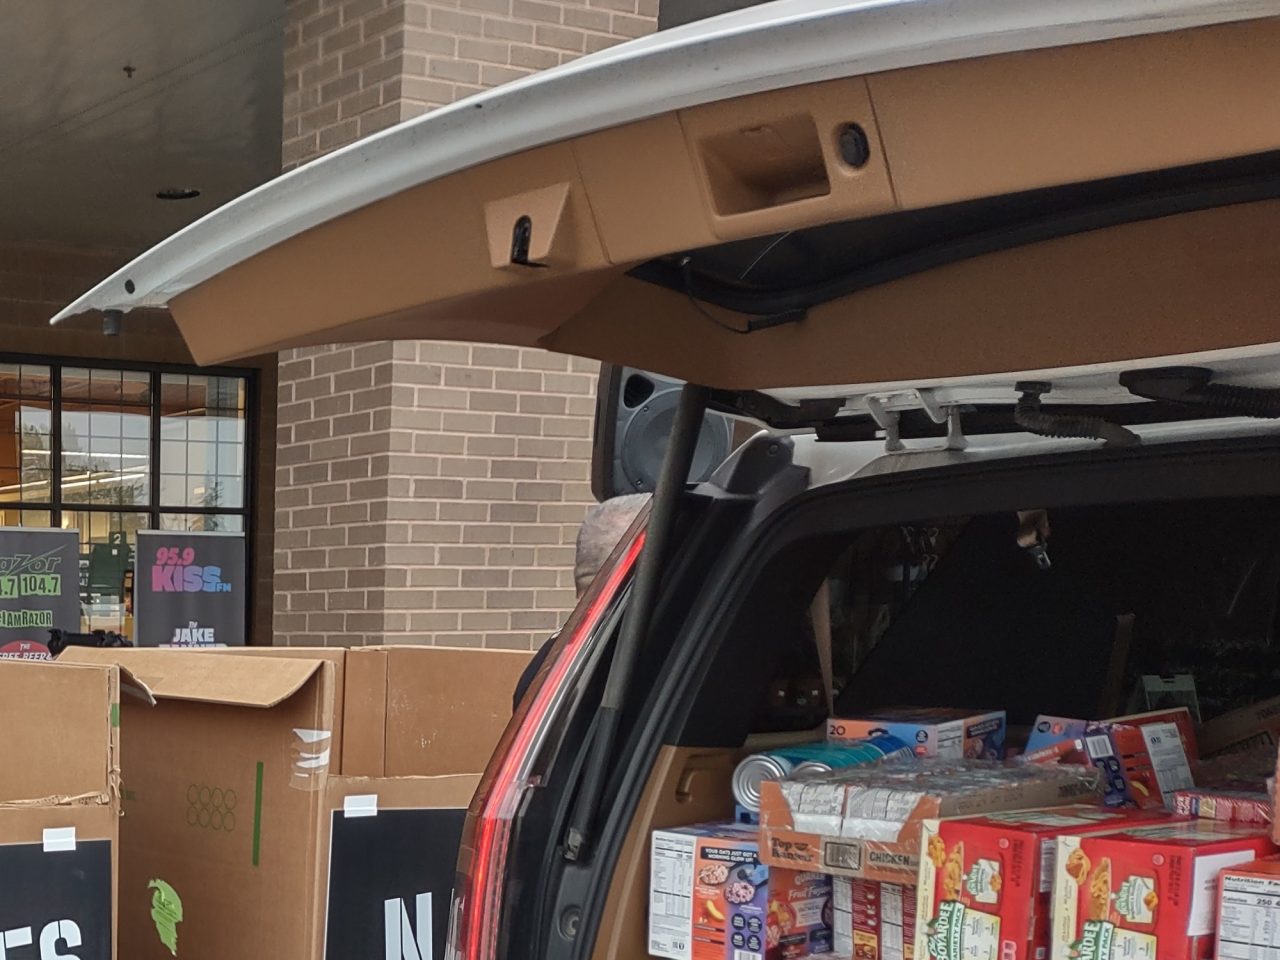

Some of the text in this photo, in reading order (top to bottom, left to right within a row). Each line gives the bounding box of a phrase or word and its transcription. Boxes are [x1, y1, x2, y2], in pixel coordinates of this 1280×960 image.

[156, 547, 195, 565] 95.9
[22, 576, 59, 593] 104.7
[152, 565, 232, 593] KISS FM
[173, 628, 215, 642] JAKE
[829, 725, 846, 736] 20
[771, 837, 792, 851] Top
[954, 906, 963, 929] PACK
[1102, 926, 1111, 949] PACK
